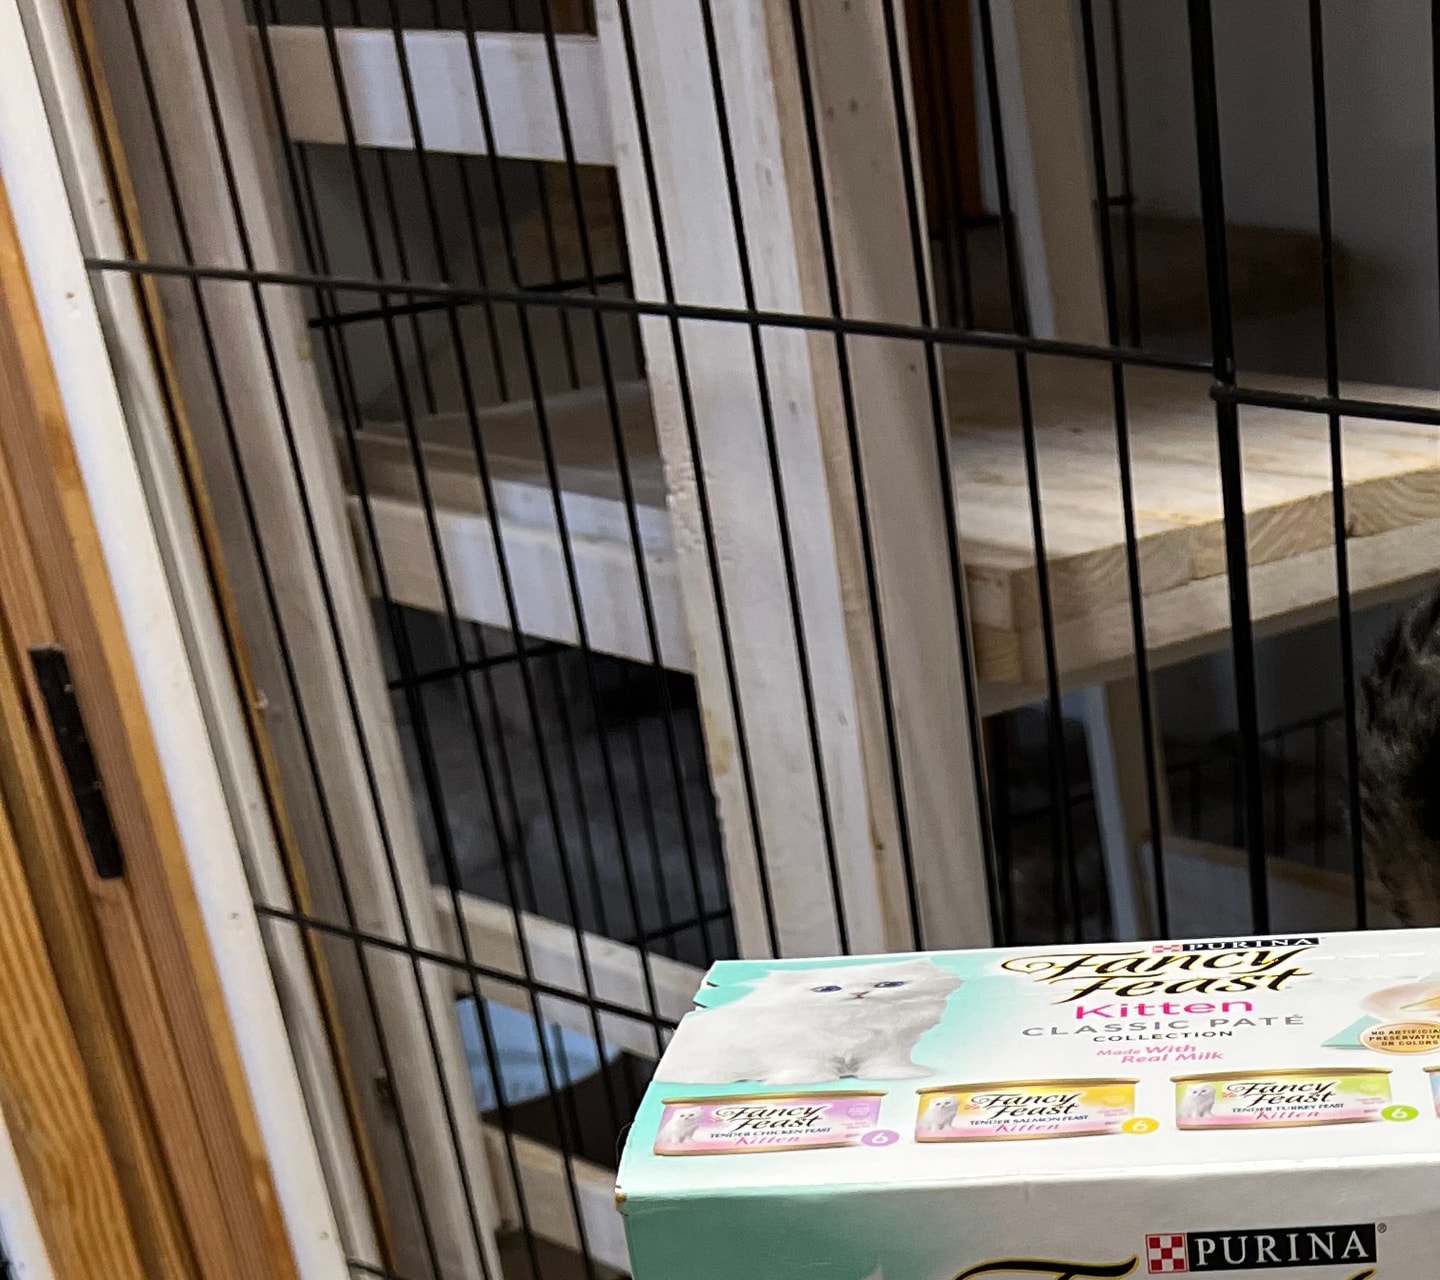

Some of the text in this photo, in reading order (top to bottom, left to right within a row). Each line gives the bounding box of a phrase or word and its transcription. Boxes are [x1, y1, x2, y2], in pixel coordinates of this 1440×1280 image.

[1189, 938, 1318, 952] PURINA
[1001, 946, 1316, 982] Fancy
[1033, 968, 1315, 1005] Feast
[1075, 1000, 1253, 1019] Kitten
[1022, 1014, 1304, 1037] CLASSIC PATÉ
[1093, 1030, 1233, 1042] COLLECTION
[1097, 1044, 1196, 1057] Made With
[1121, 1051, 1224, 1064] Real Milk
[1194, 1229, 1370, 1268] PURINA
